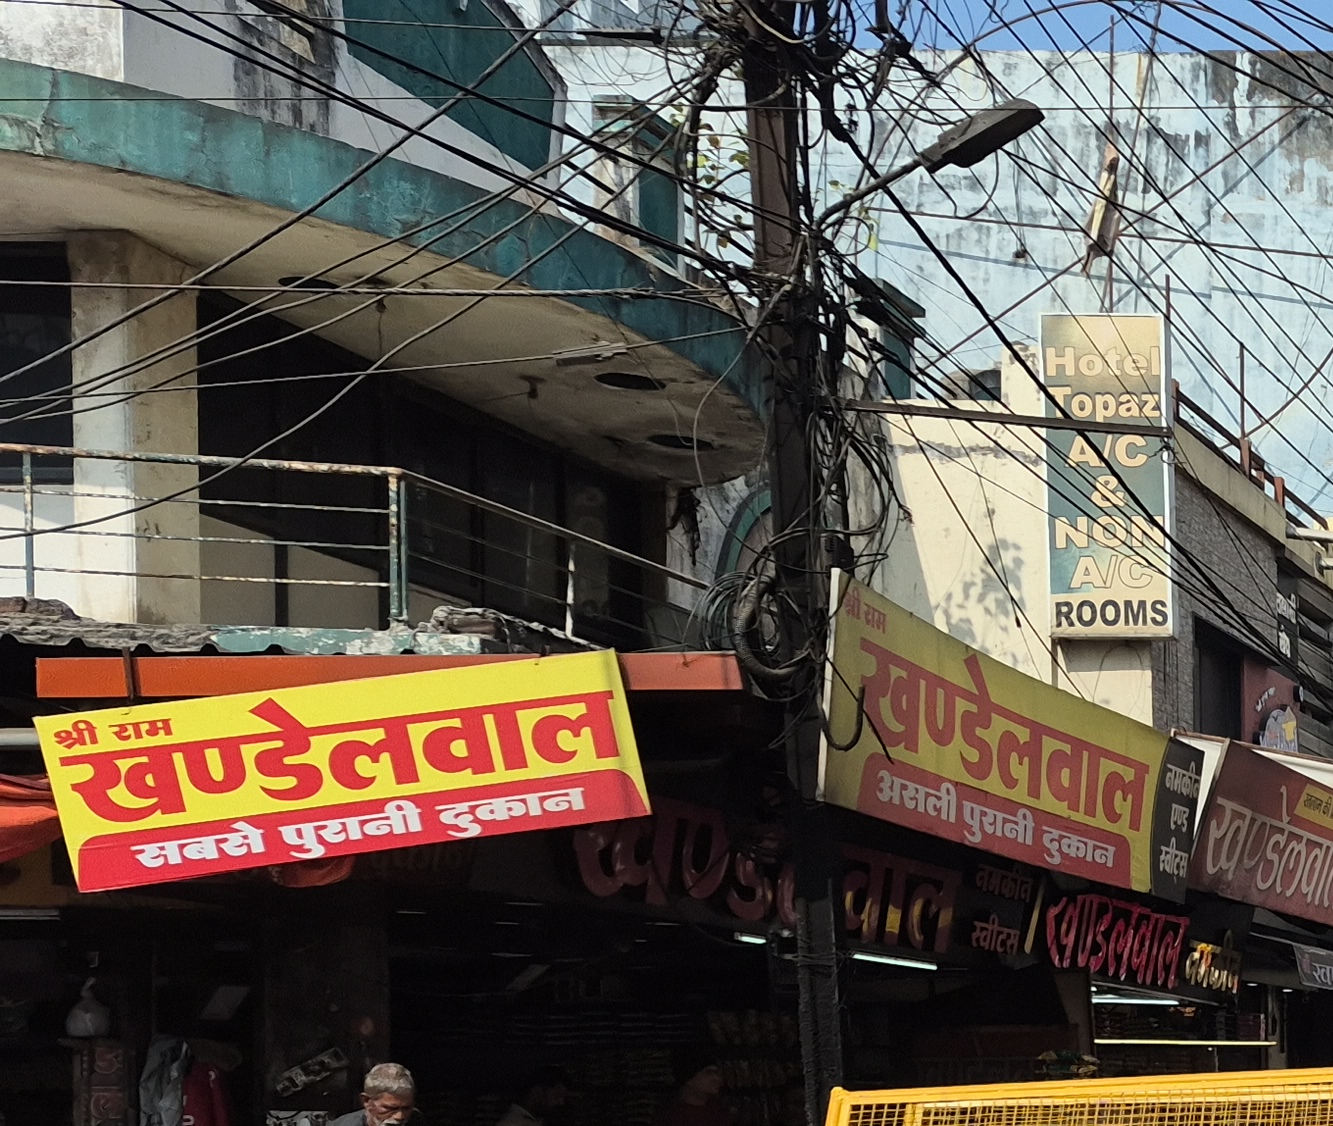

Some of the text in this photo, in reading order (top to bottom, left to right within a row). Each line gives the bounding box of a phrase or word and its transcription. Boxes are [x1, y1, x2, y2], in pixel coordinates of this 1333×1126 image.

[1045, 346, 1160, 377] Hotel
[1045, 386, 1161, 422] Topaz
[1065, 434, 1149, 468] A/C
[1090, 475, 1128, 508] &
[1055, 515, 1167, 550] NON
[1069, 555, 1153, 590] A/C
[1054, 598, 1169, 629] ROOMS
[53, 716, 173, 751] श्री राम
[858, 638, 1150, 832] खण्डेलवाल
[60, 690, 622, 824] खण्डेलवाल
[134, 820, 266, 869] सबसे
[282, 799, 425, 861] पुरानी
[435, 786, 587, 840] दुकान
[876, 769, 1117, 867] असली पुरानी दुकान
